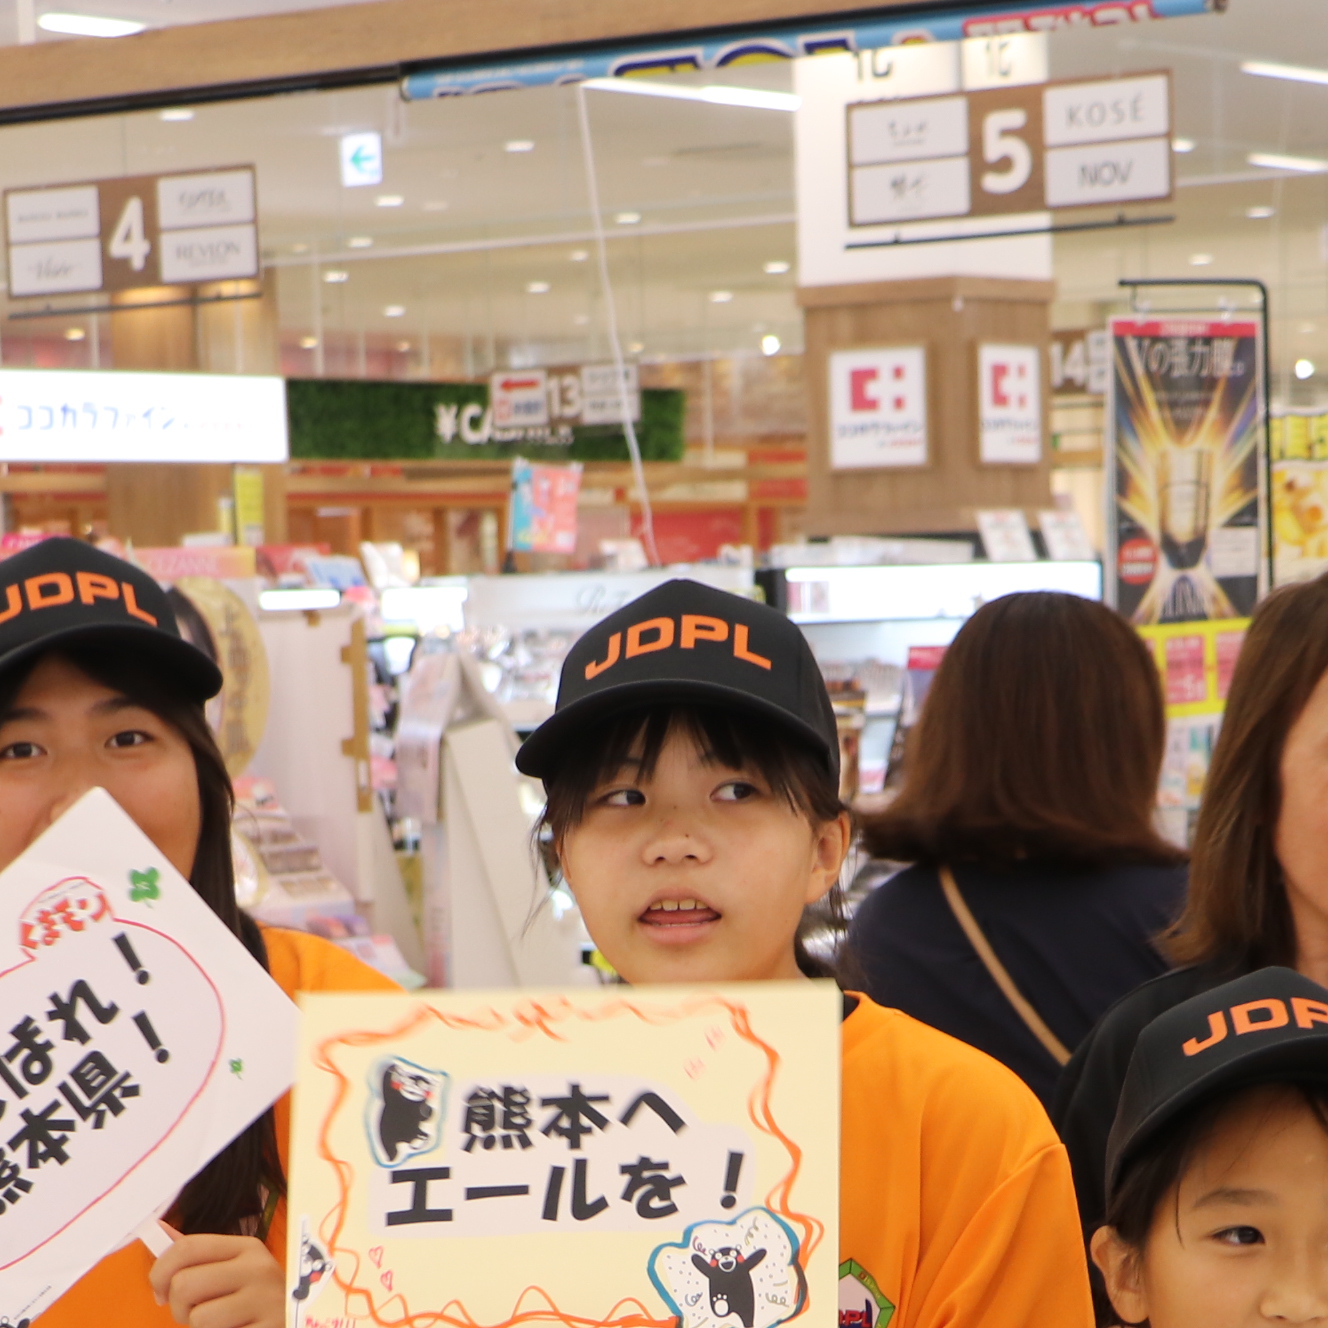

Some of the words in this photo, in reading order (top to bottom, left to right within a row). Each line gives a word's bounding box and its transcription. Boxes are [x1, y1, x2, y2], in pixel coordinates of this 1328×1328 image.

[1065, 92, 1146, 127] KOSÉ
[980, 107, 1032, 195] 5
[1077, 158, 1134, 189] NOV
[108, 194, 151, 272] 4
[545, 373, 581, 419] 13
[584, 614, 772, 681] JDPL
[462, 1083, 688, 1154] 熊本へ
